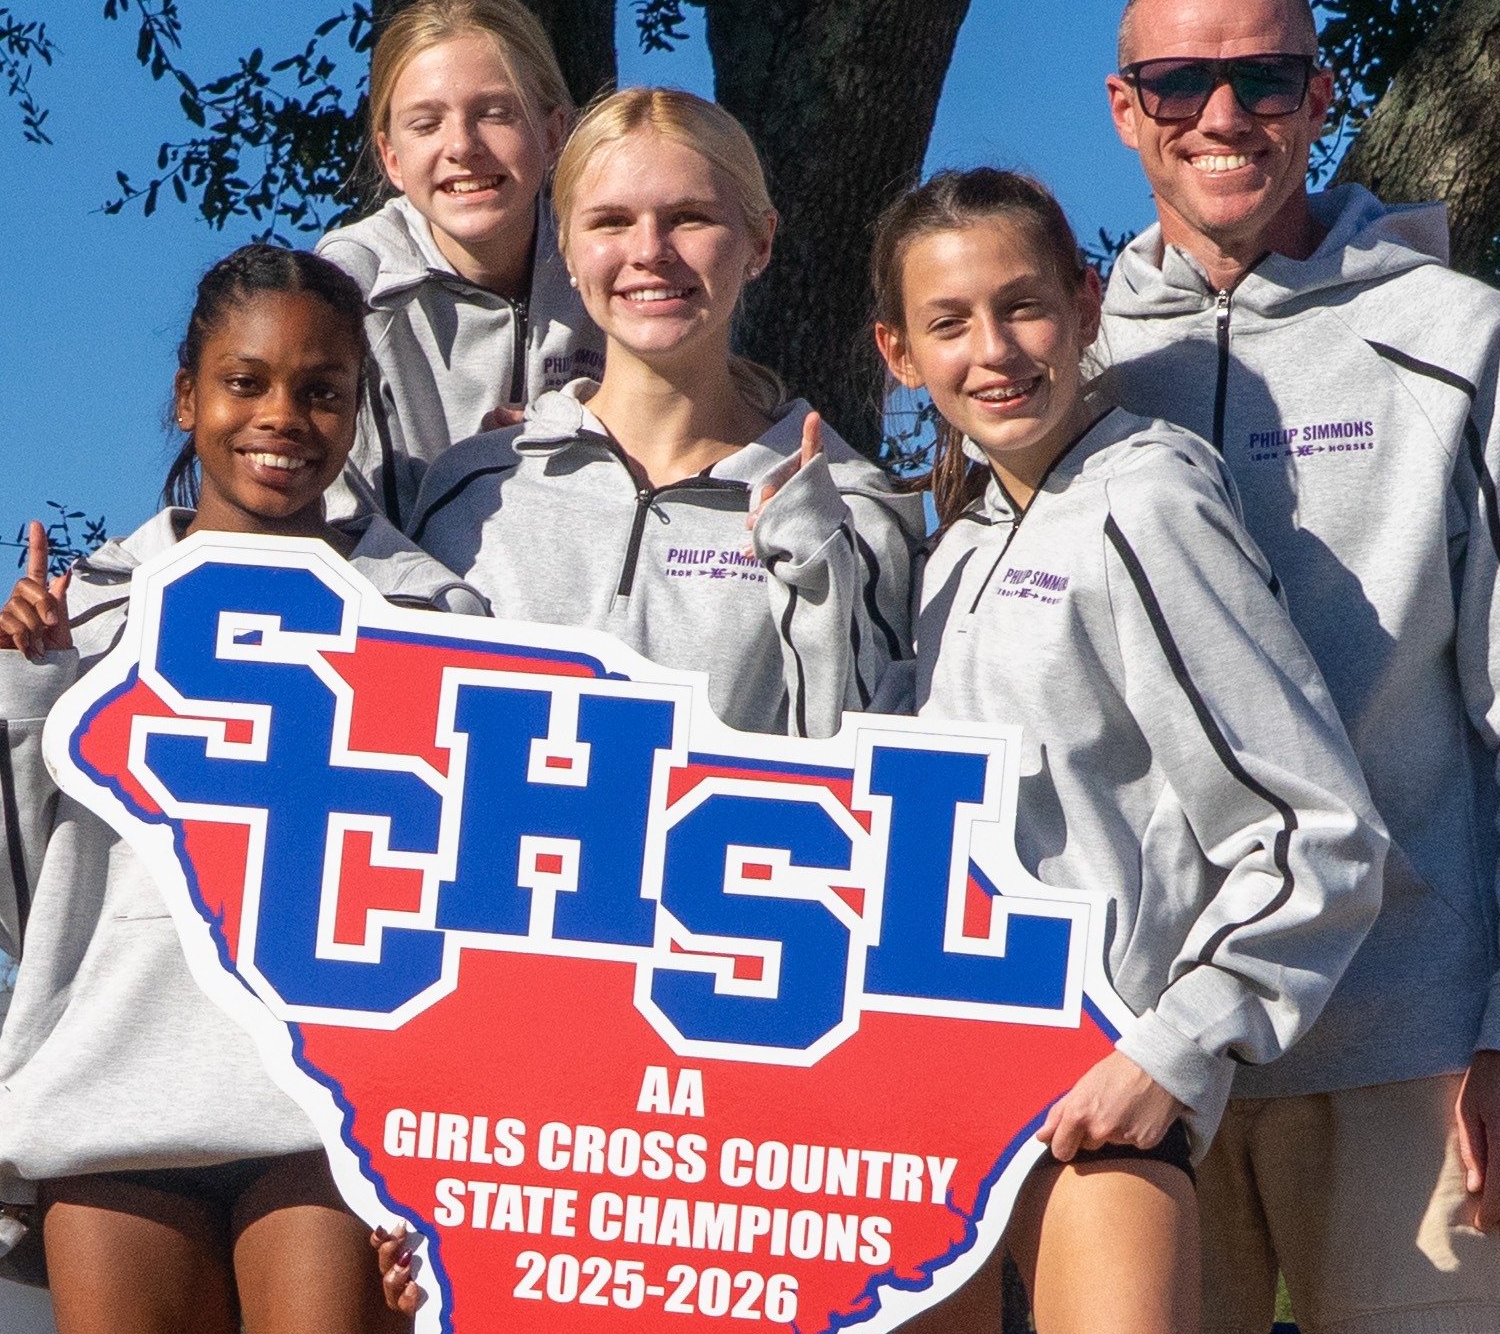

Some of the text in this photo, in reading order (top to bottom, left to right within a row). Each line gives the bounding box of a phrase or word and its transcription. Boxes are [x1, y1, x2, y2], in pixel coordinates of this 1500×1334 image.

[1250, 421, 1374, 448] PHILIP SIMMONS
[1329, 443, 1374, 452] HORSES
[665, 568, 692, 576] IRON
[667, 548, 715, 564] PHILIP
[138, 552, 1082, 1059] SCHSL
[636, 1065, 706, 1118] AA
[383, 1108, 958, 1205] GIRLS CROSS COUNTRY
[433, 1177, 893, 1265] STATE CHAMPIONS
[512, 1250, 799, 1323] 2025-2026
